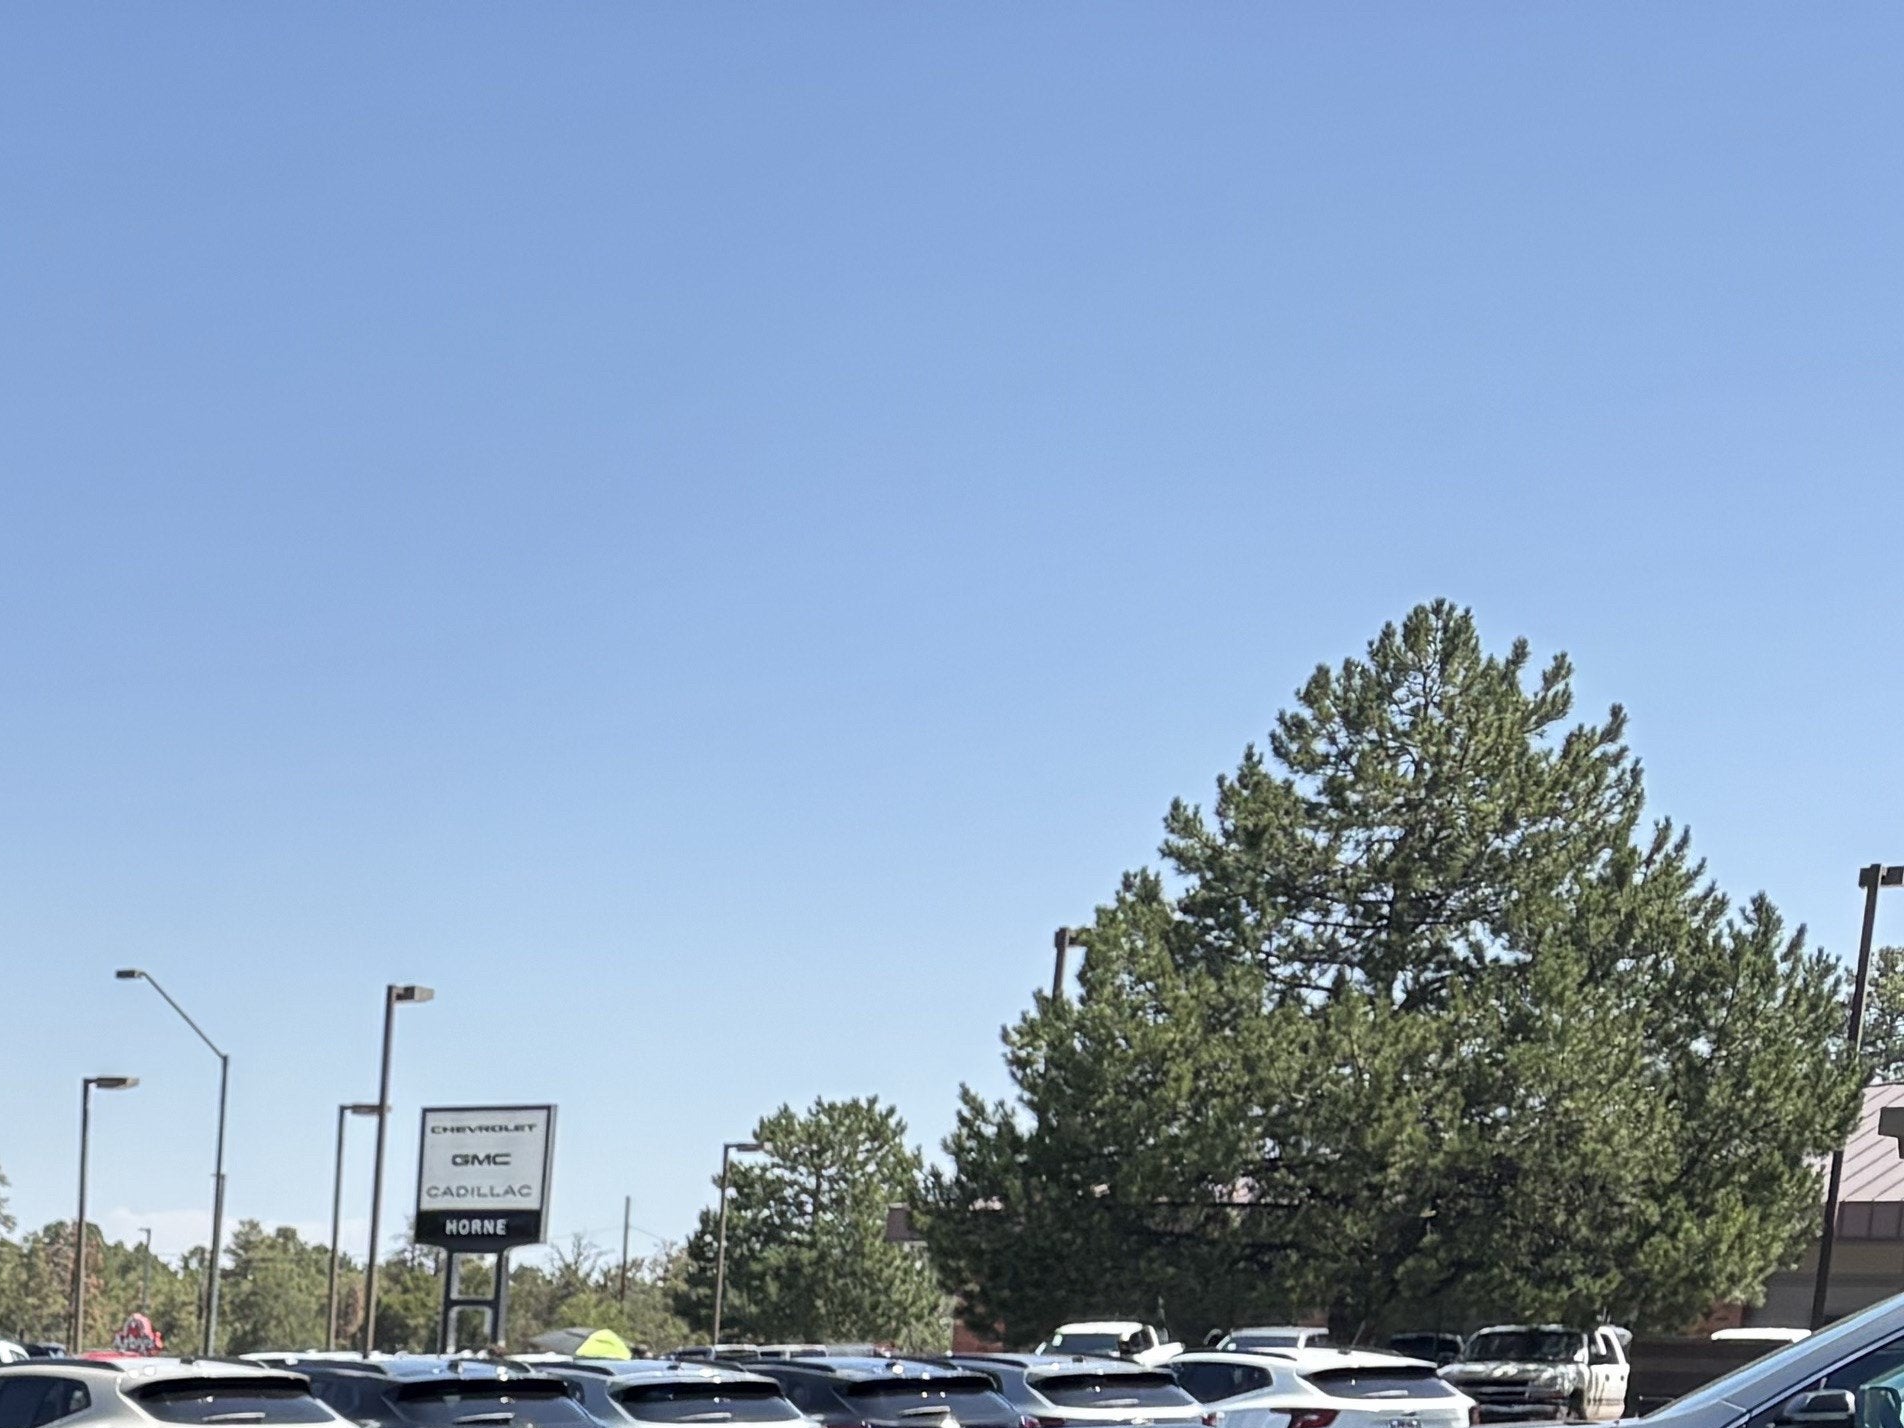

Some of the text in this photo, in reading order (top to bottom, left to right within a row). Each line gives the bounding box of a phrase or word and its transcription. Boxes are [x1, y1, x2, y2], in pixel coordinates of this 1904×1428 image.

[431, 1123, 537, 1134] CHEVROLET
[451, 1153, 511, 1166] GMC
[426, 1184, 532, 1198] CADILLAC
[445, 1219, 509, 1235] HORNE
